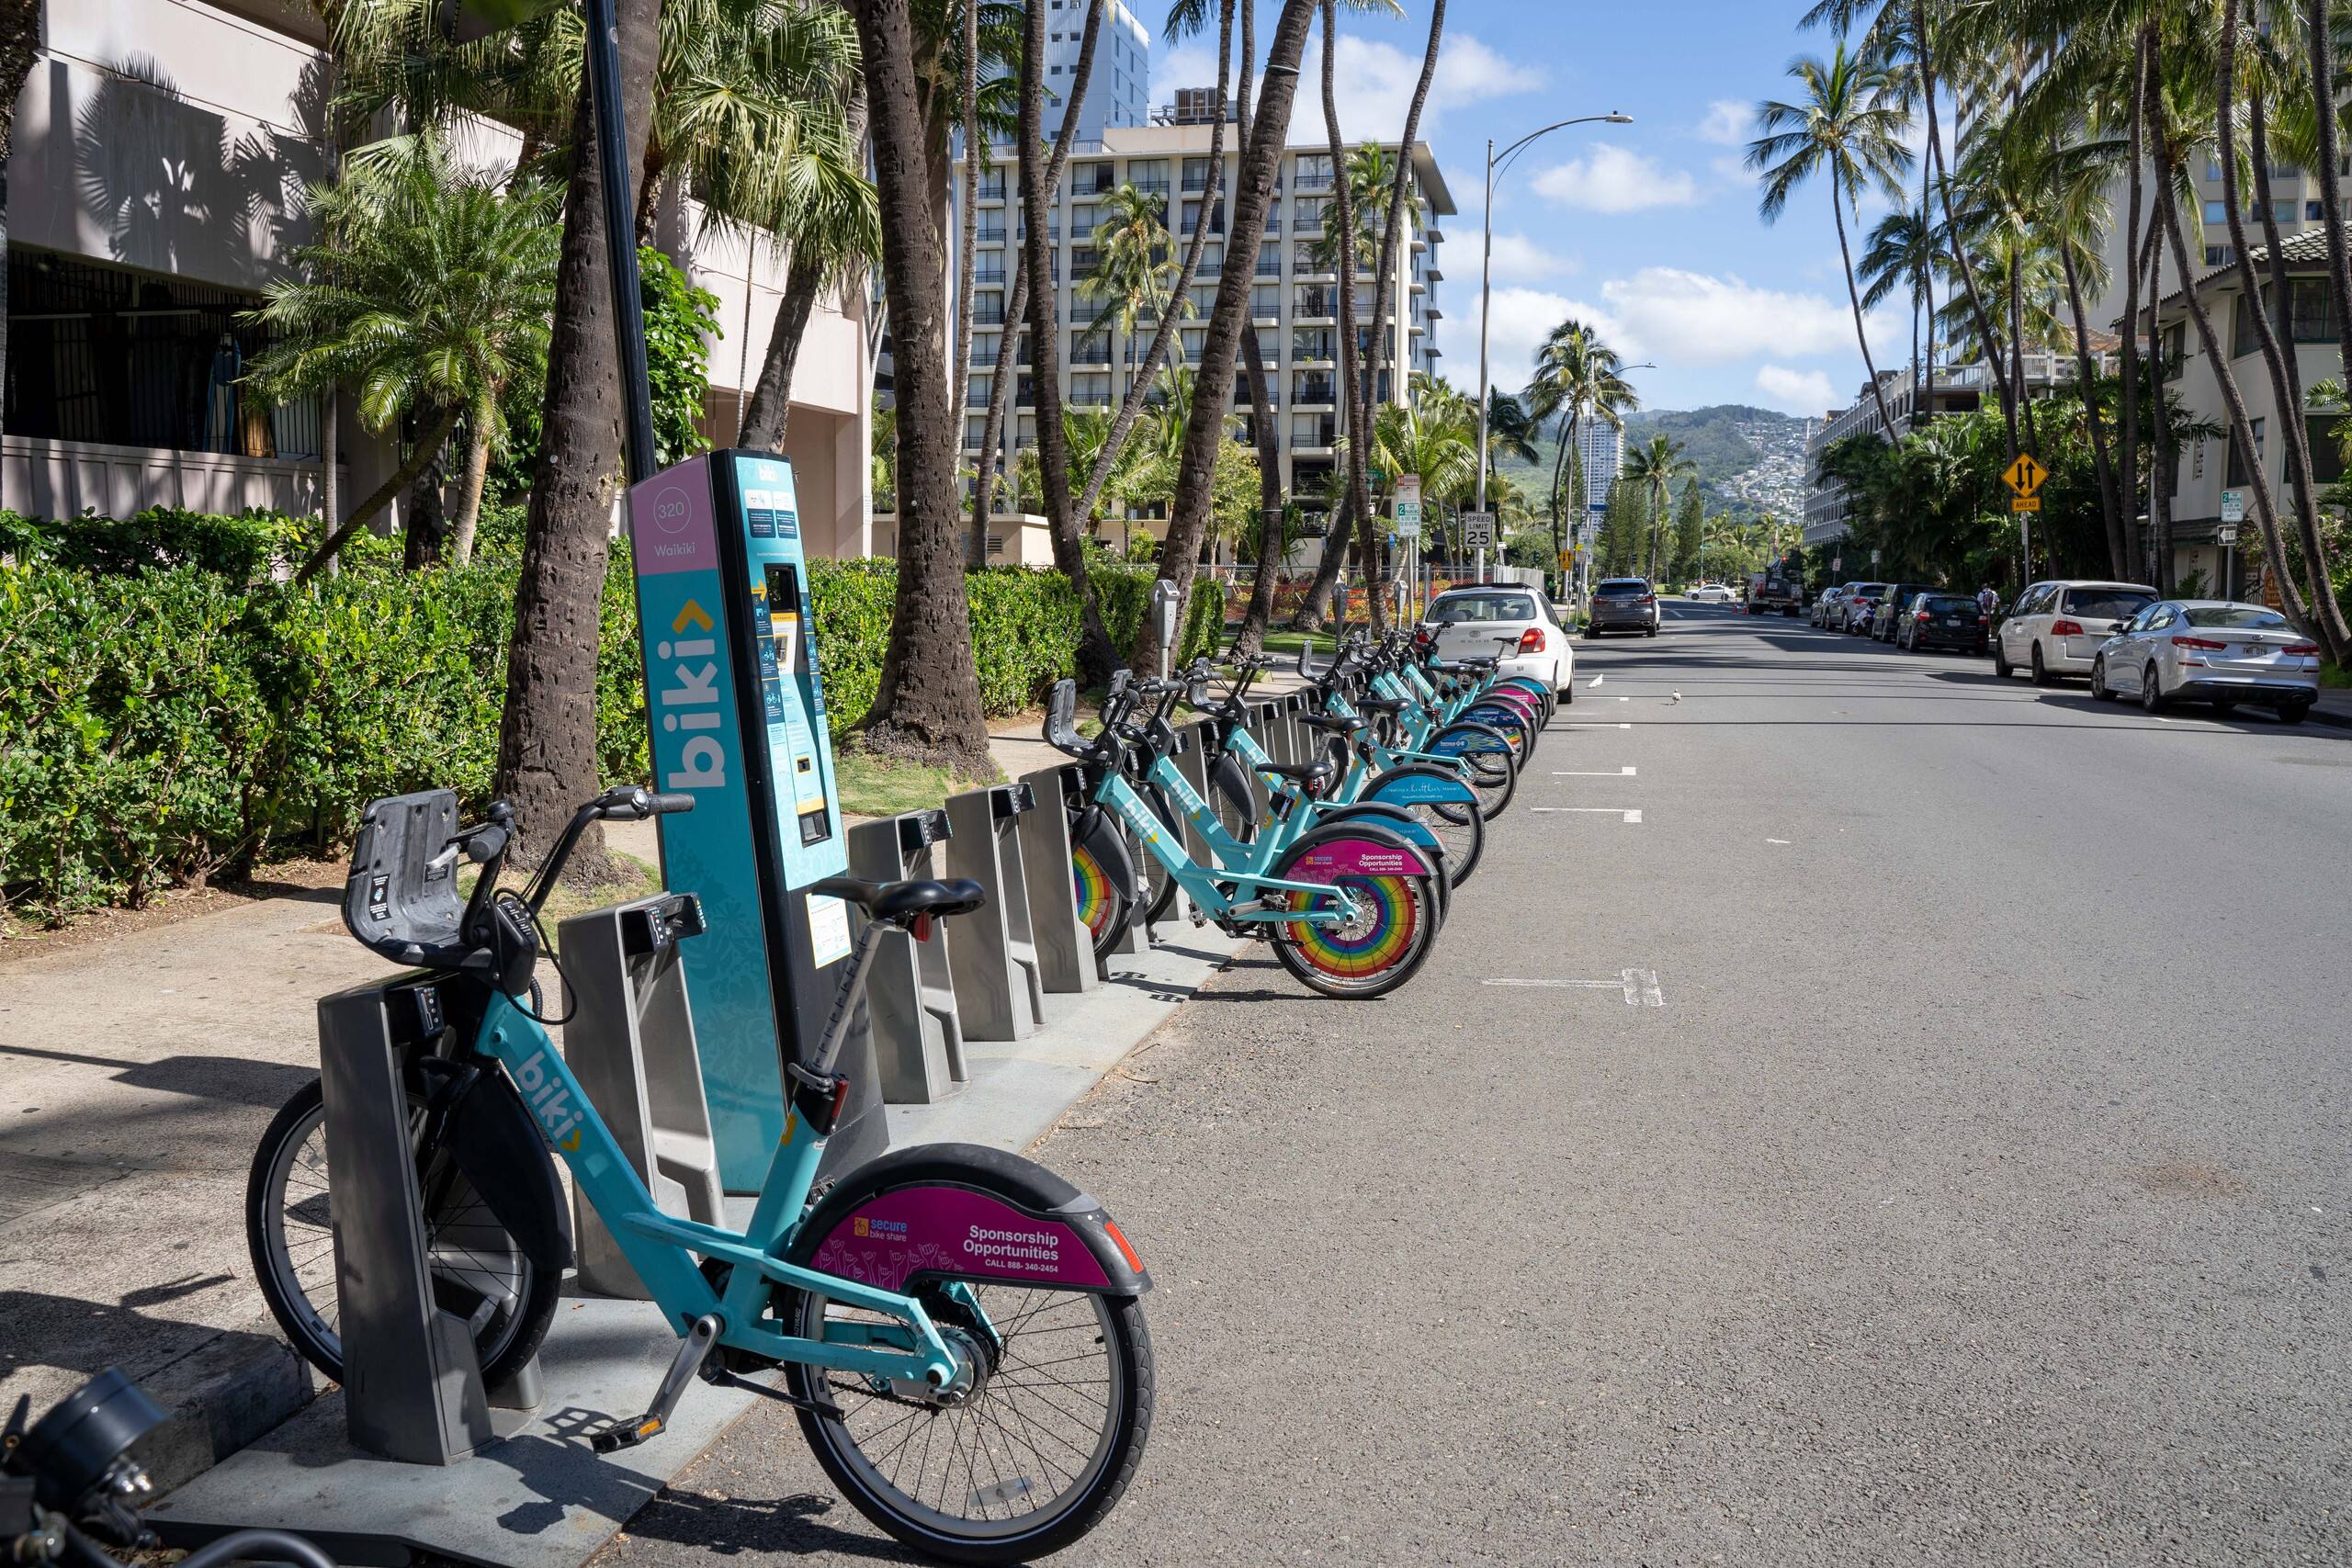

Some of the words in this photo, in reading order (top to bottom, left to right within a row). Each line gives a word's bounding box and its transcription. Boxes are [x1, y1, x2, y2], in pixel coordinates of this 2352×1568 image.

[658, 502, 684, 519] 320
[1399, 505, 1405, 514] 2
[1467, 532, 1488, 544] 25
[654, 542, 695, 558] Waikiki
[658, 639, 726, 788] biki
[1169, 778, 1201, 815] biki
[1120, 797, 1158, 838] biki
[514, 1050, 583, 1139] biki
[870, 1219, 908, 1233] secure
[869, 1230, 885, 1240] bike
[887, 1233, 908, 1242] share
[969, 1224, 1058, 1248] Sponsorship
[963, 1239, 1058, 1260] Opportunities
[985, 1258, 1006, 1268] CALL
